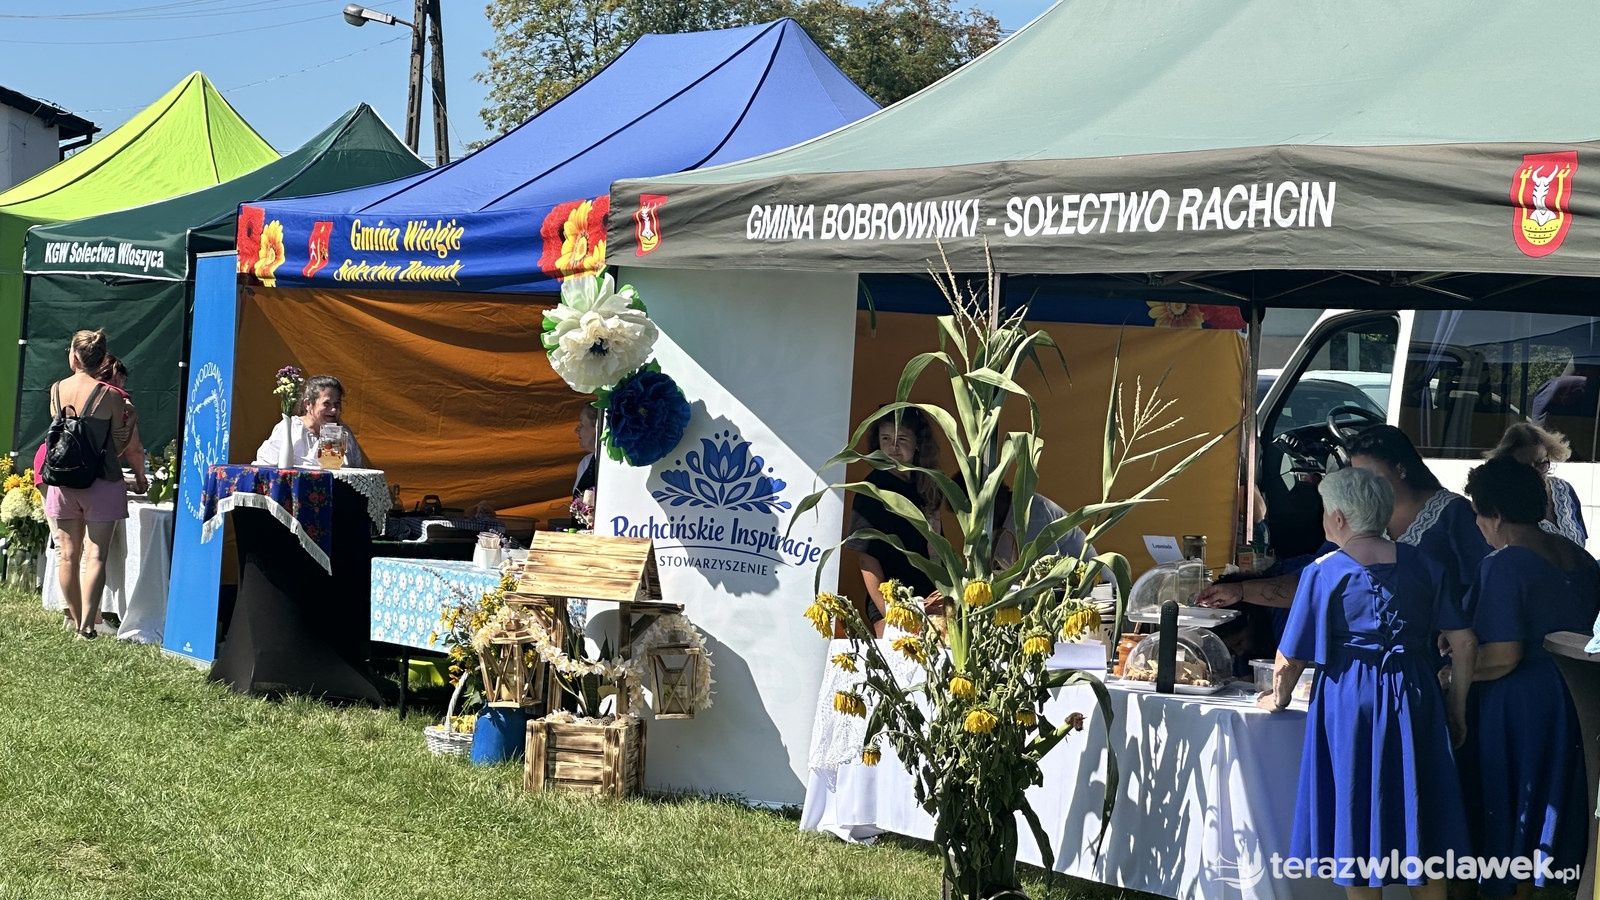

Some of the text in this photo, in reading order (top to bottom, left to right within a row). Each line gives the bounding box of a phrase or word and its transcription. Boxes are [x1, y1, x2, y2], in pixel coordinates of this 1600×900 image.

[746, 204, 814, 239] GMINA
[820, 199, 979, 240] BOBROWNIKI
[1004, 189, 1170, 237] SOŁECTWO
[1176, 181, 1336, 231] RACHCIN
[44, 242, 71, 264] KGW
[350, 218, 465, 259] Gmina Wielgie
[610, 515, 822, 566] Rachcińskie Inspiracje
[659, 555, 768, 577] STOWARZYSZENIE
